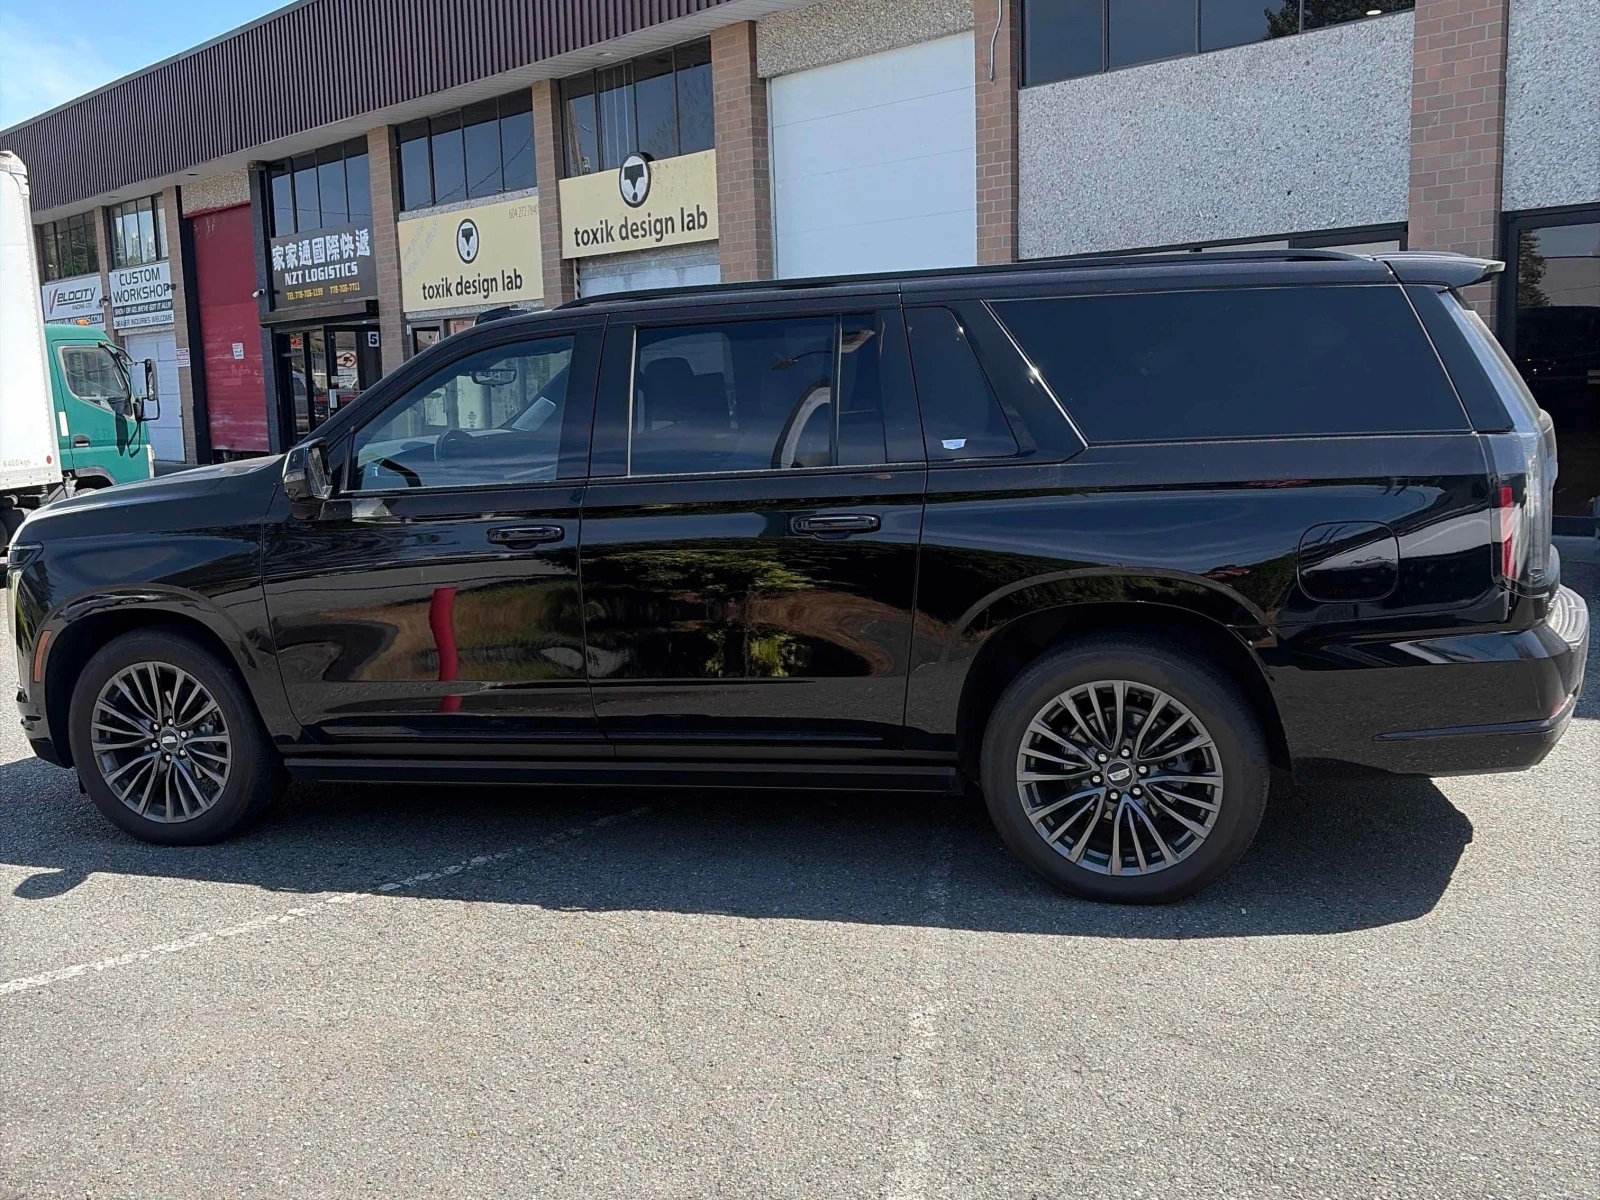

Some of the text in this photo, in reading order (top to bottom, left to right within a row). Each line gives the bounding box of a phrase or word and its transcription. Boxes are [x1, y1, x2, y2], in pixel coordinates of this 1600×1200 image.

[574, 204, 708, 247] toxik design lab
[272, 228, 371, 271] 家家通國際快遞
[119, 267, 160, 286] CUSTOM
[285, 261, 358, 286] NZT LOGISTICS
[422, 268, 523, 300] toxik design lab
[113, 283, 169, 303] WORKSHOP
[151, 313, 173, 323] WELCOME
[369, 333, 378, 345] 5
